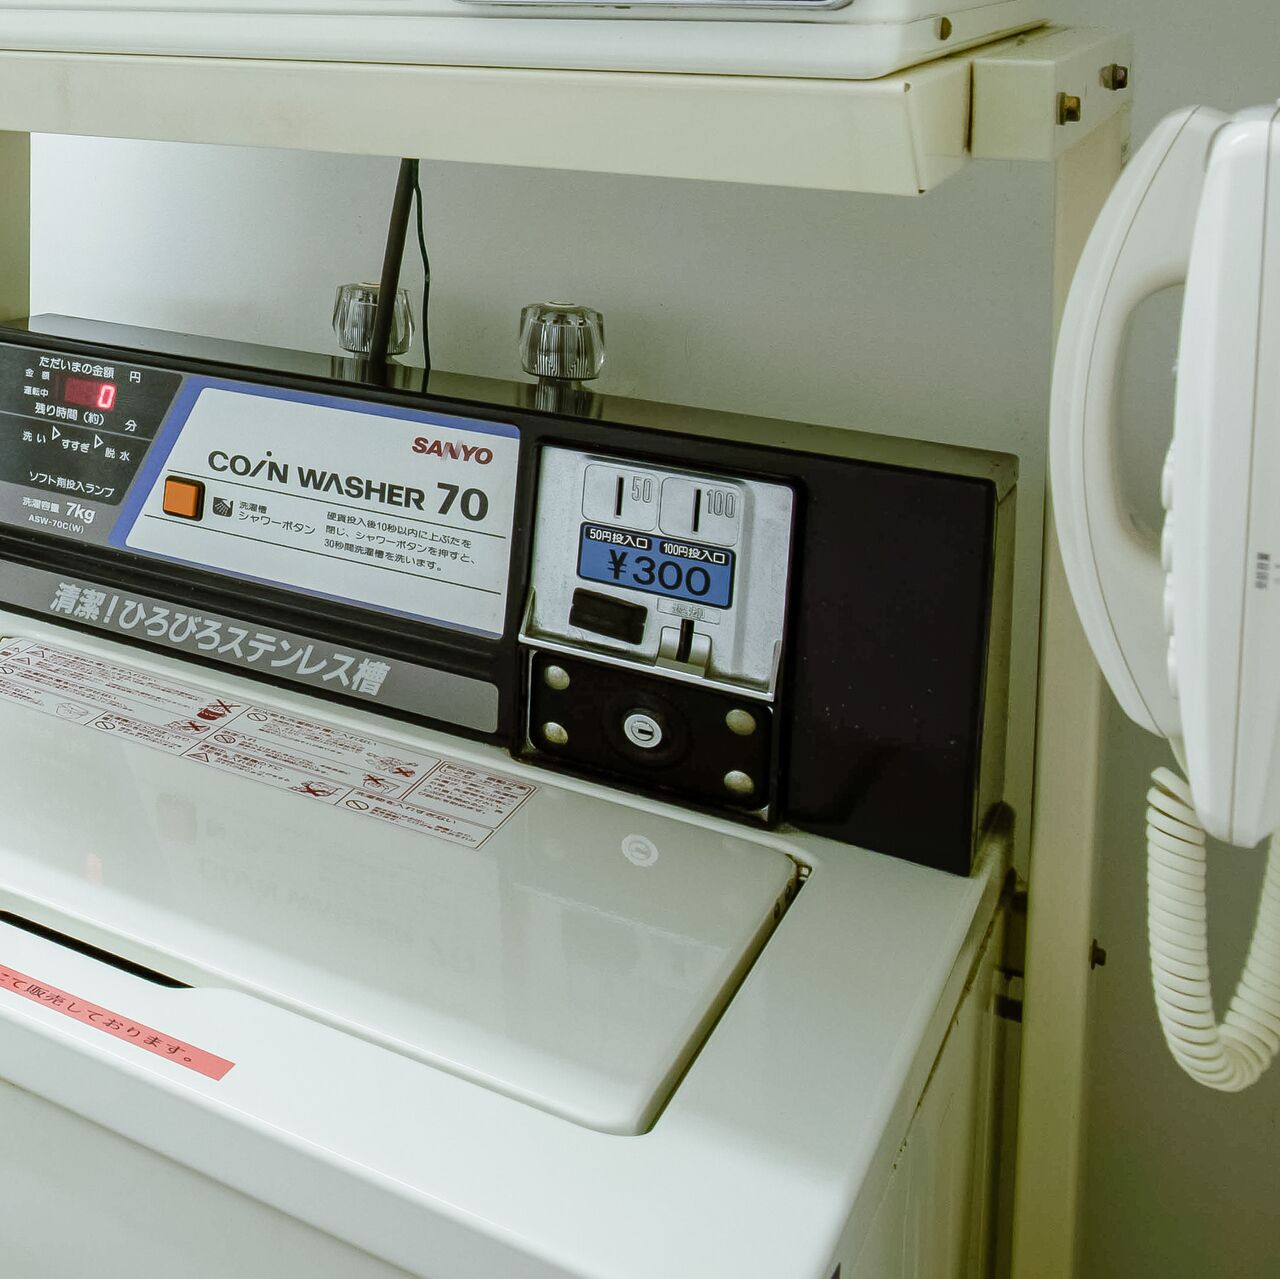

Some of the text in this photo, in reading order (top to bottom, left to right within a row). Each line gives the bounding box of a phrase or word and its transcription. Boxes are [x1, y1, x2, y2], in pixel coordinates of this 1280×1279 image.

[39, 356, 141, 384] ただいまの金額 円
[23, 385, 49, 398] 運転中
[97, 384, 117, 409] 0
[124, 419, 138, 432] 分
[22, 430, 130, 462] 洗い すすぎ 脱水
[411, 436, 493, 465] SANYO
[29, 471, 115, 498] ソフト剤投入ランプ
[297, 466, 425, 511] WASHER
[436, 482, 489, 522] 70
[631, 476, 652, 504] 50
[22, 496, 96, 524] 洗濯容量 7kg
[239, 501, 268, 515] 洗濯槽
[706, 489, 736, 518] 100
[28, 514, 84, 534] ASW-70C(W)
[238, 511, 316, 536] シャワーボタン
[326, 511, 472, 549] 硬貨投入後10秒以内に上ぶたを
[325, 525, 477, 565] 閉じ、シャワーボタンを押すと、
[589, 528, 648, 549] 50円投入口
[323, 538, 443, 572] 30秒間洗濯槽を洗います。
[663, 542, 726, 564] 100円投入口
[607, 548, 711, 596] ¥300
[49, 581, 392, 696] 清潔!ひろびろステンレス槽
